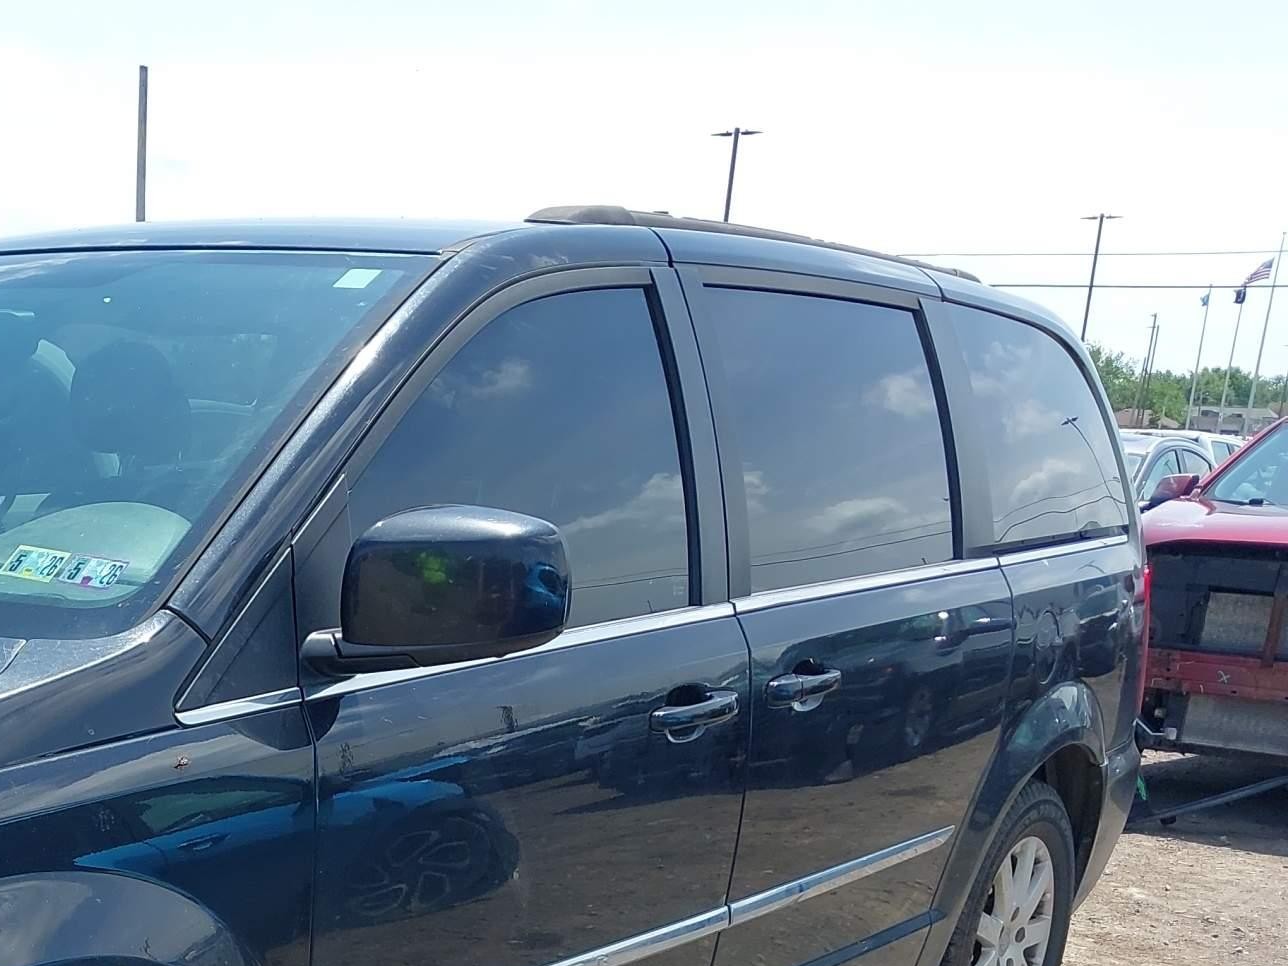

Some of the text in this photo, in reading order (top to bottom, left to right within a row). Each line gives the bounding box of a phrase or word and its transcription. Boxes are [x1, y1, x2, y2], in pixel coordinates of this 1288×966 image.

[9, 554, 65, 577] 5 26
[67, 561, 124, 585] 5 26
